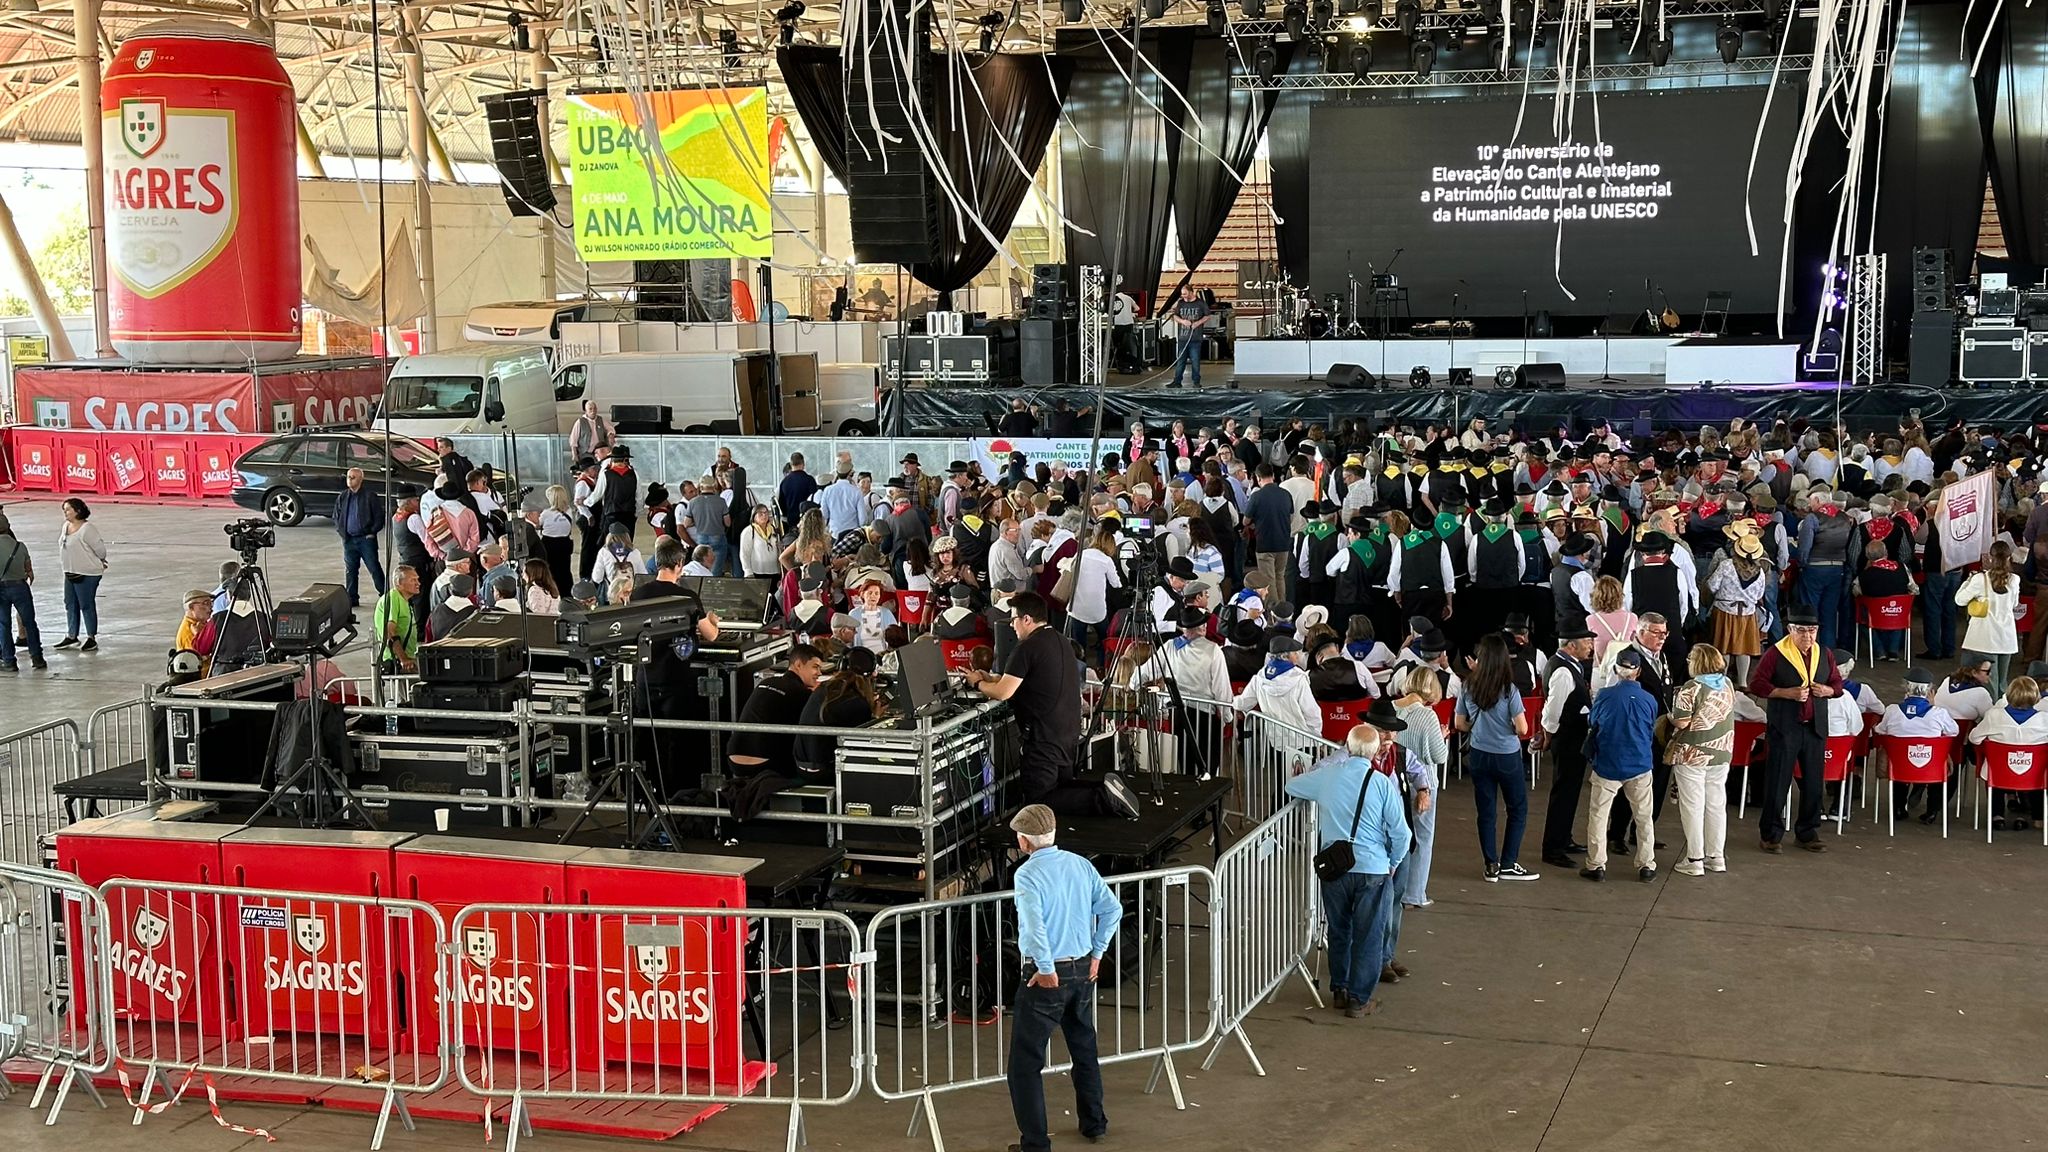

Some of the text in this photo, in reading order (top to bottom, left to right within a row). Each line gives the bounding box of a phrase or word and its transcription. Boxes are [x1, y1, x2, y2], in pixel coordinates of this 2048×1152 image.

[577, 124, 651, 156] UB40
[1502, 141, 1590, 161] aniversário
[1594, 141, 1614, 159] da
[579, 162, 619, 171] DJ ZANOVA
[1431, 161, 1660, 184] Elevação do Cante Alentejano
[112, 163, 225, 215] AGRES
[1420, 189, 1431, 202] a
[1434, 184, 1518, 203] Património
[1520, 182, 1584, 201] Cultural
[1586, 185, 1597, 199] e
[584, 203, 759, 238] ANA MOURA
[1432, 202, 1659, 223] da Humanidade pela UNESCO
[584, 245, 594, 253] DJ
[595, 243, 623, 253] WILSON
[624, 242, 660, 252] HONRADO
[662, 240, 688, 253] (RÁDIO
[1056, 443, 1087, 451] CANTE
[1103, 443, 1123, 451] ANO
[23, 463, 51, 478] SAGRES
[66, 464, 96, 481] SAGRES
[110, 452, 131, 487] SAGRES
[157, 468, 186, 481] SAGRES
[202, 470, 231, 484] SAGRES
[258, 909, 285, 918] POLÍCIA
[263, 955, 365, 996] SAGRES
[606, 985, 711, 1025] SAGRES
